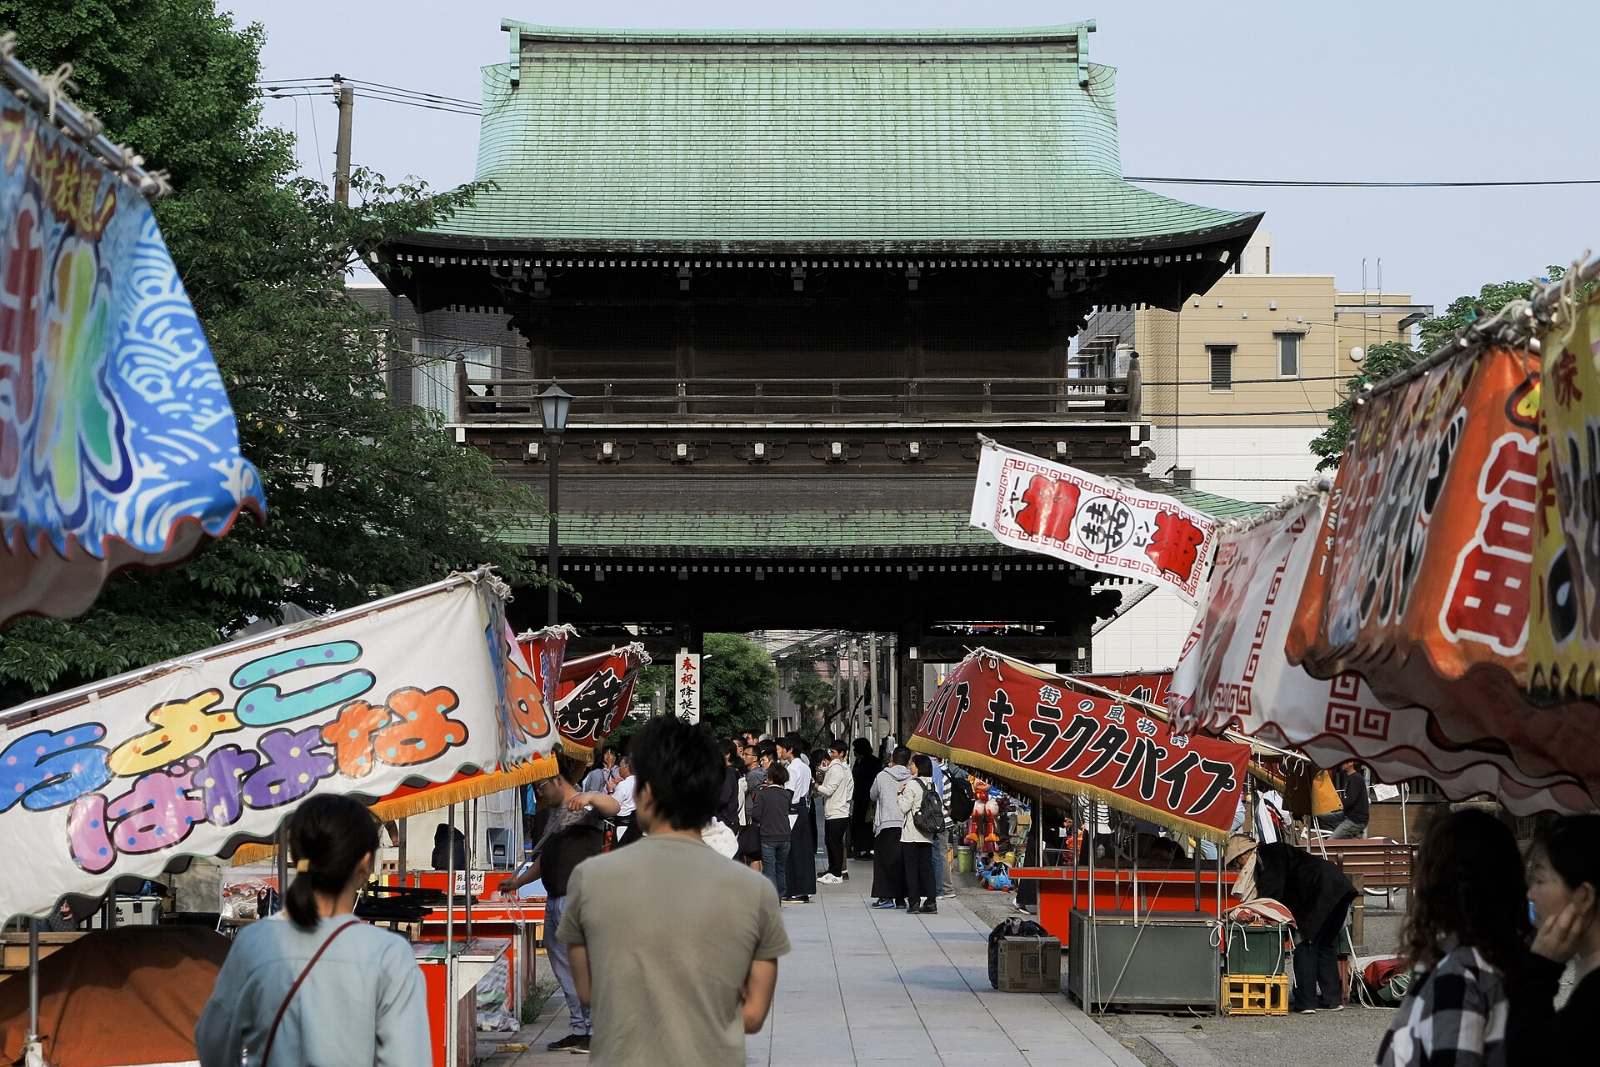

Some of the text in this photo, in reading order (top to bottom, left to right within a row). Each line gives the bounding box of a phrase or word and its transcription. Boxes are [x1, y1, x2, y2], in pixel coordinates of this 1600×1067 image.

[0, 640, 377, 814] ちょこ
[67, 684, 470, 875] ばなな
[983, 688, 1238, 816] キャラクターパイプ
[1039, 685, 1189, 748] 街の風物詩
[457, 873, 483, 882] おやげ
